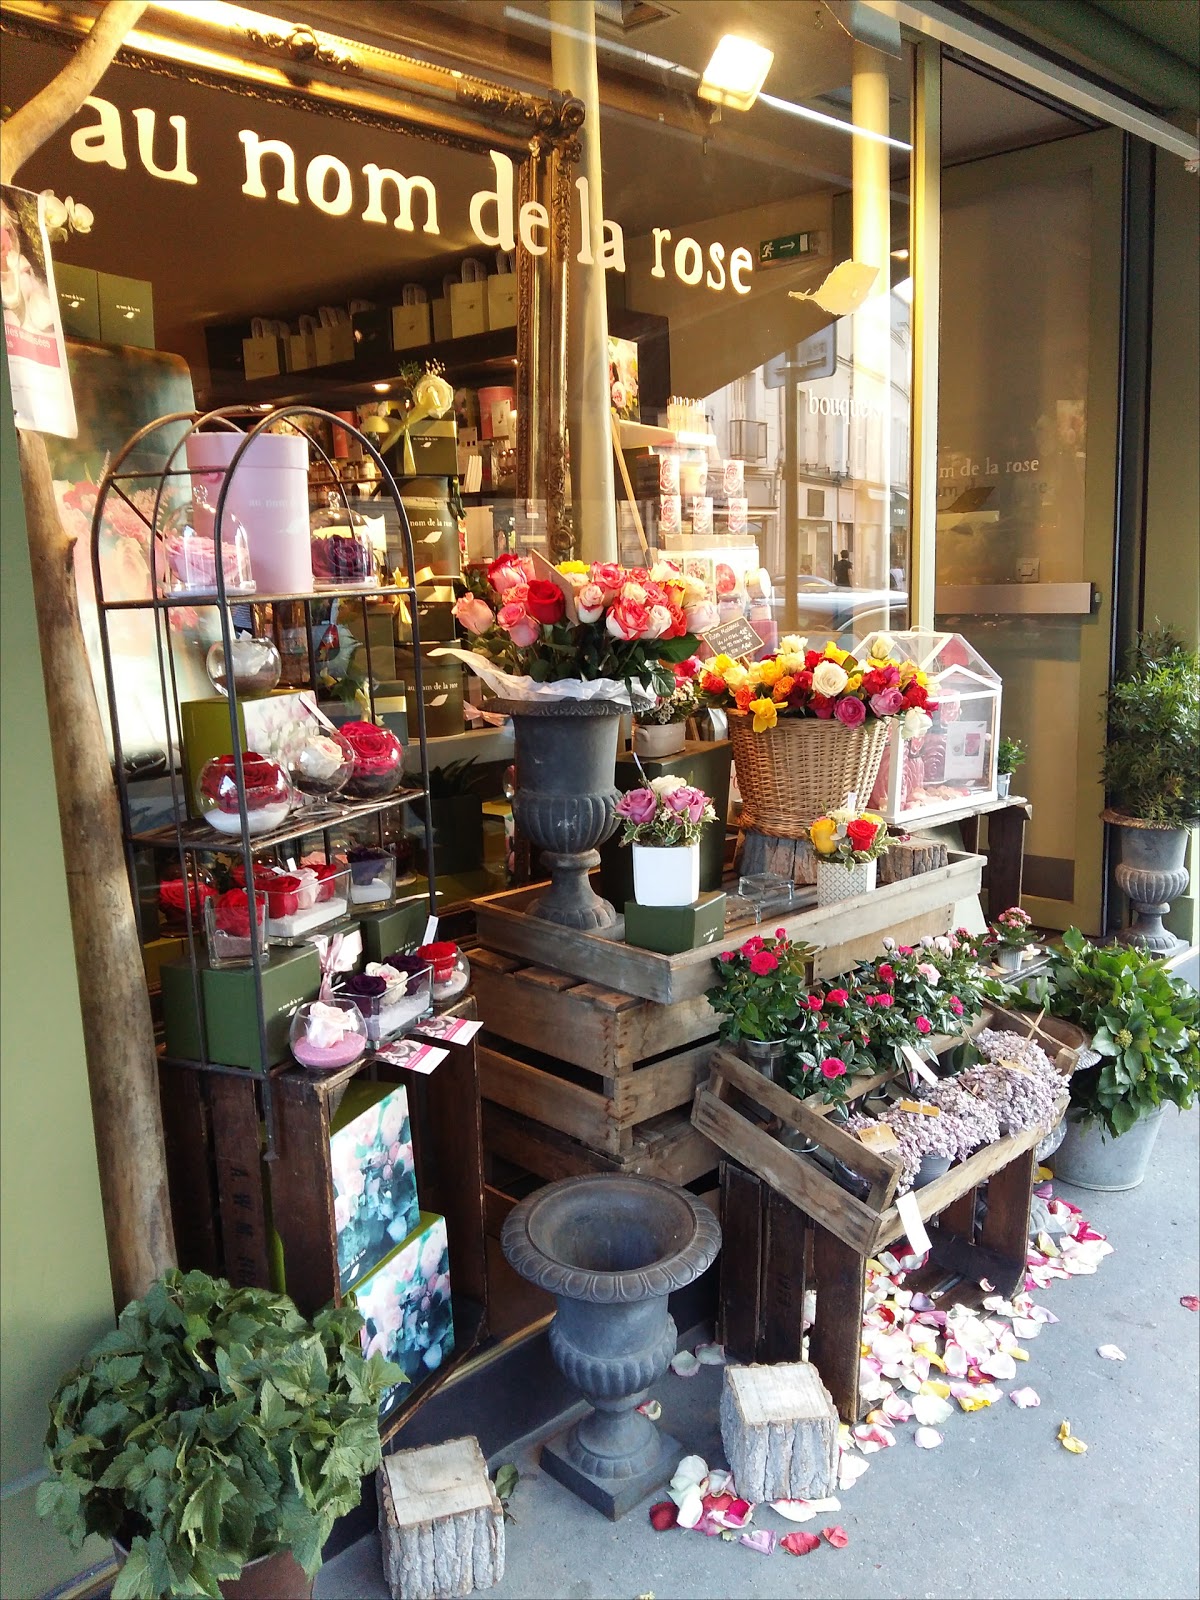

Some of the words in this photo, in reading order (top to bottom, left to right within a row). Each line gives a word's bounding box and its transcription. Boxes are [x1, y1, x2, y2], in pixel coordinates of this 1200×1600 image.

[70, 95, 198, 186] au
[238, 129, 441, 235] nom
[469, 149, 549, 256] de
[575, 176, 626, 273] la
[650, 227, 754, 295] rose
[808, 388, 881, 425] bouques
[960, 457, 980, 477] de
[984, 457, 1000, 476] la
[1005, 458, 1040, 474] rose
